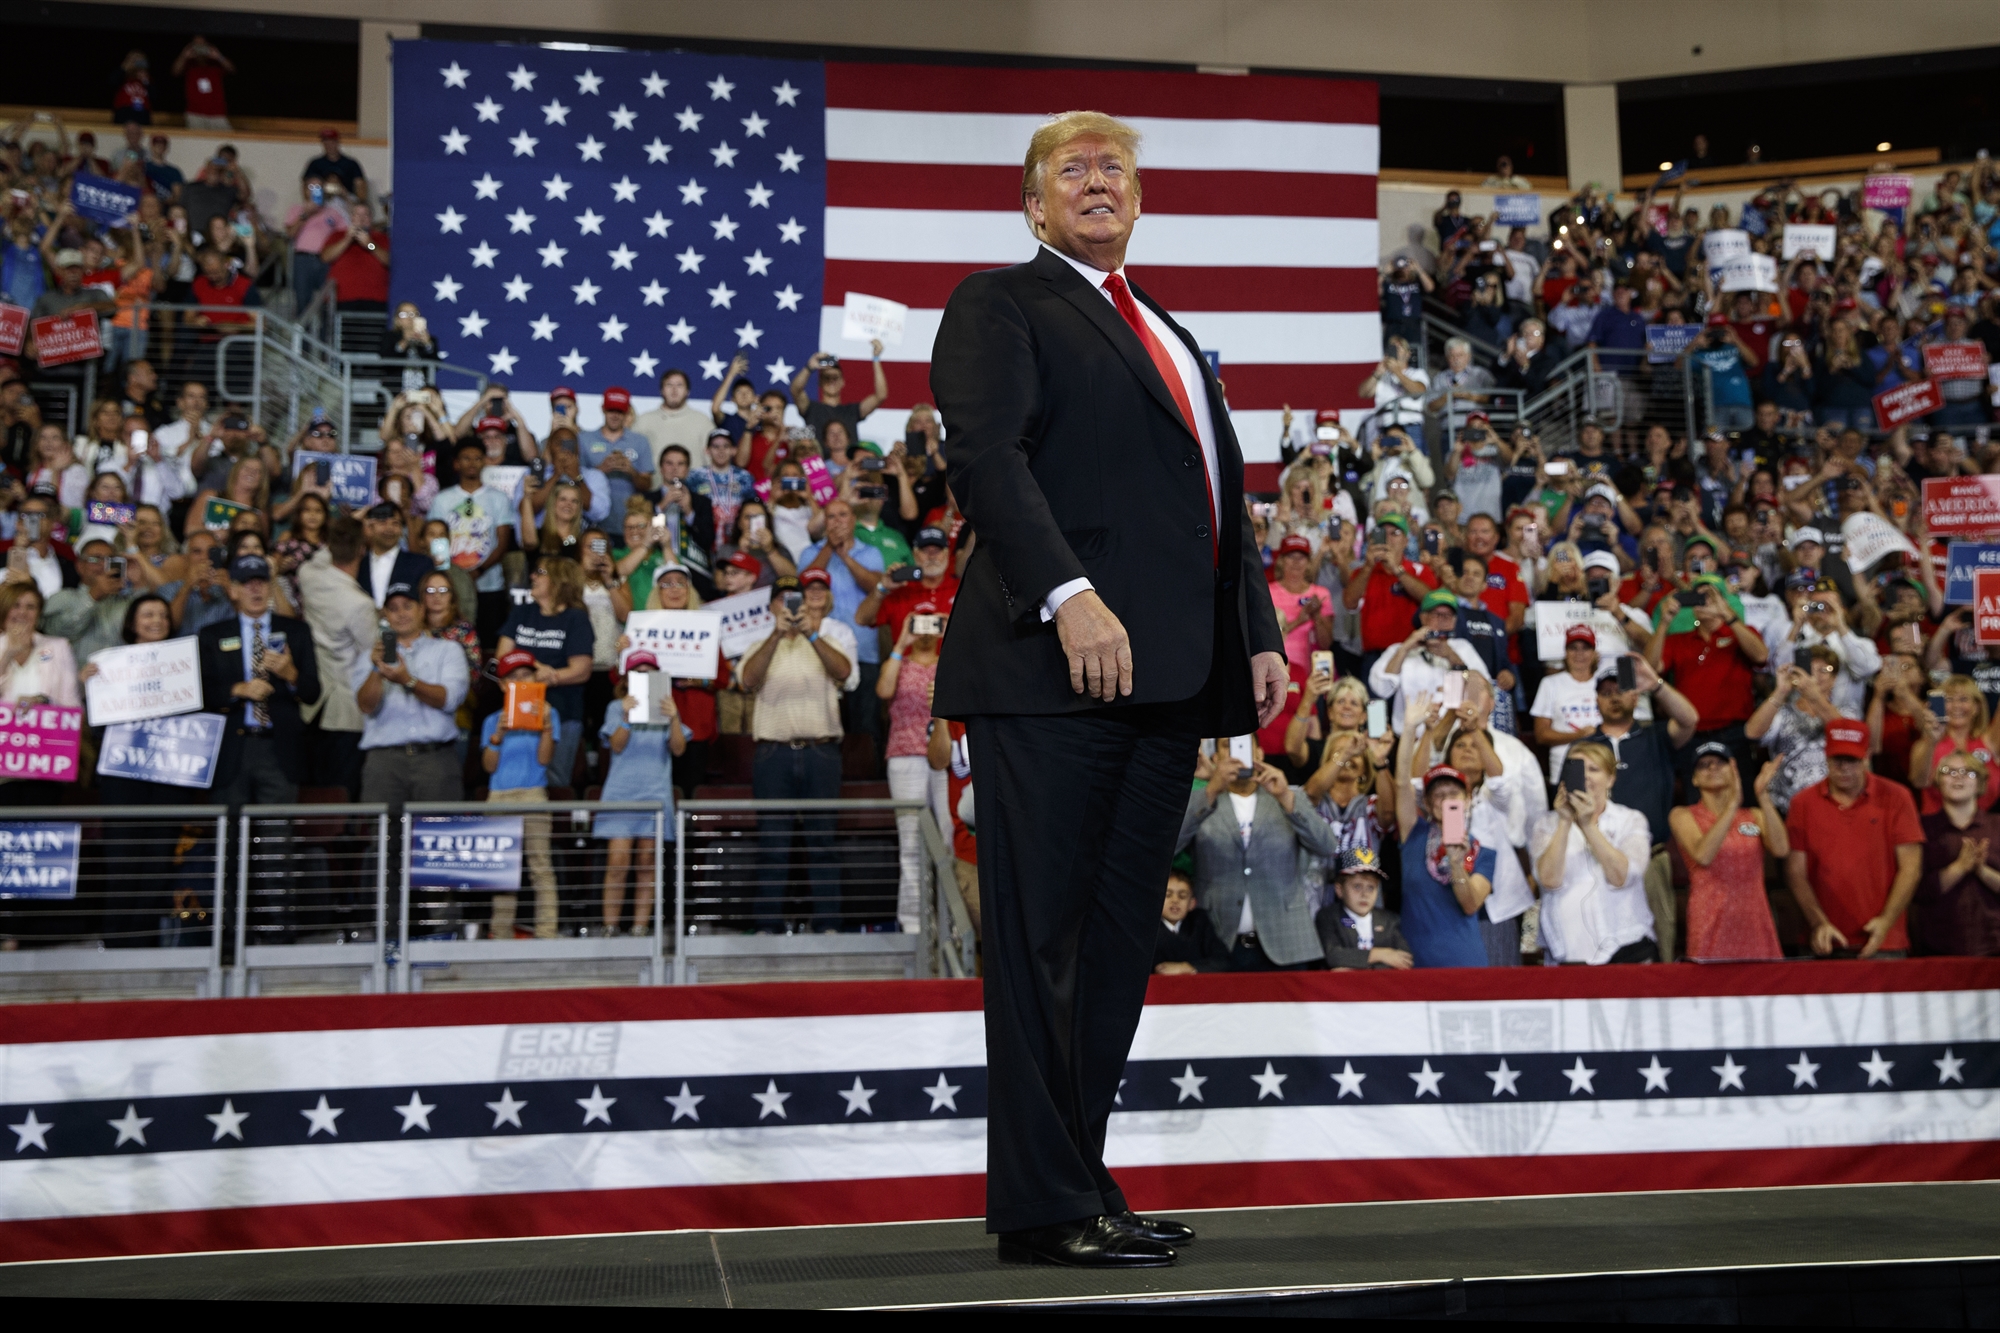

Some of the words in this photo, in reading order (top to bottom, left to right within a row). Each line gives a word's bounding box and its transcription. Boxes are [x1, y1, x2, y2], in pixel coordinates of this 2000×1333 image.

[632, 628, 711, 641] TRUMP
[0, 706, 82, 731] OMEN
[0, 752, 72, 775] UMP
[108, 744, 208, 777] SWAMP
[0, 830, 64, 851] RAIN
[420, 835, 514, 851] TRUMP
[0, 866, 68, 887] AMP
[508, 1026, 615, 1056] ERIE
[501, 1055, 609, 1078] SPORTS
